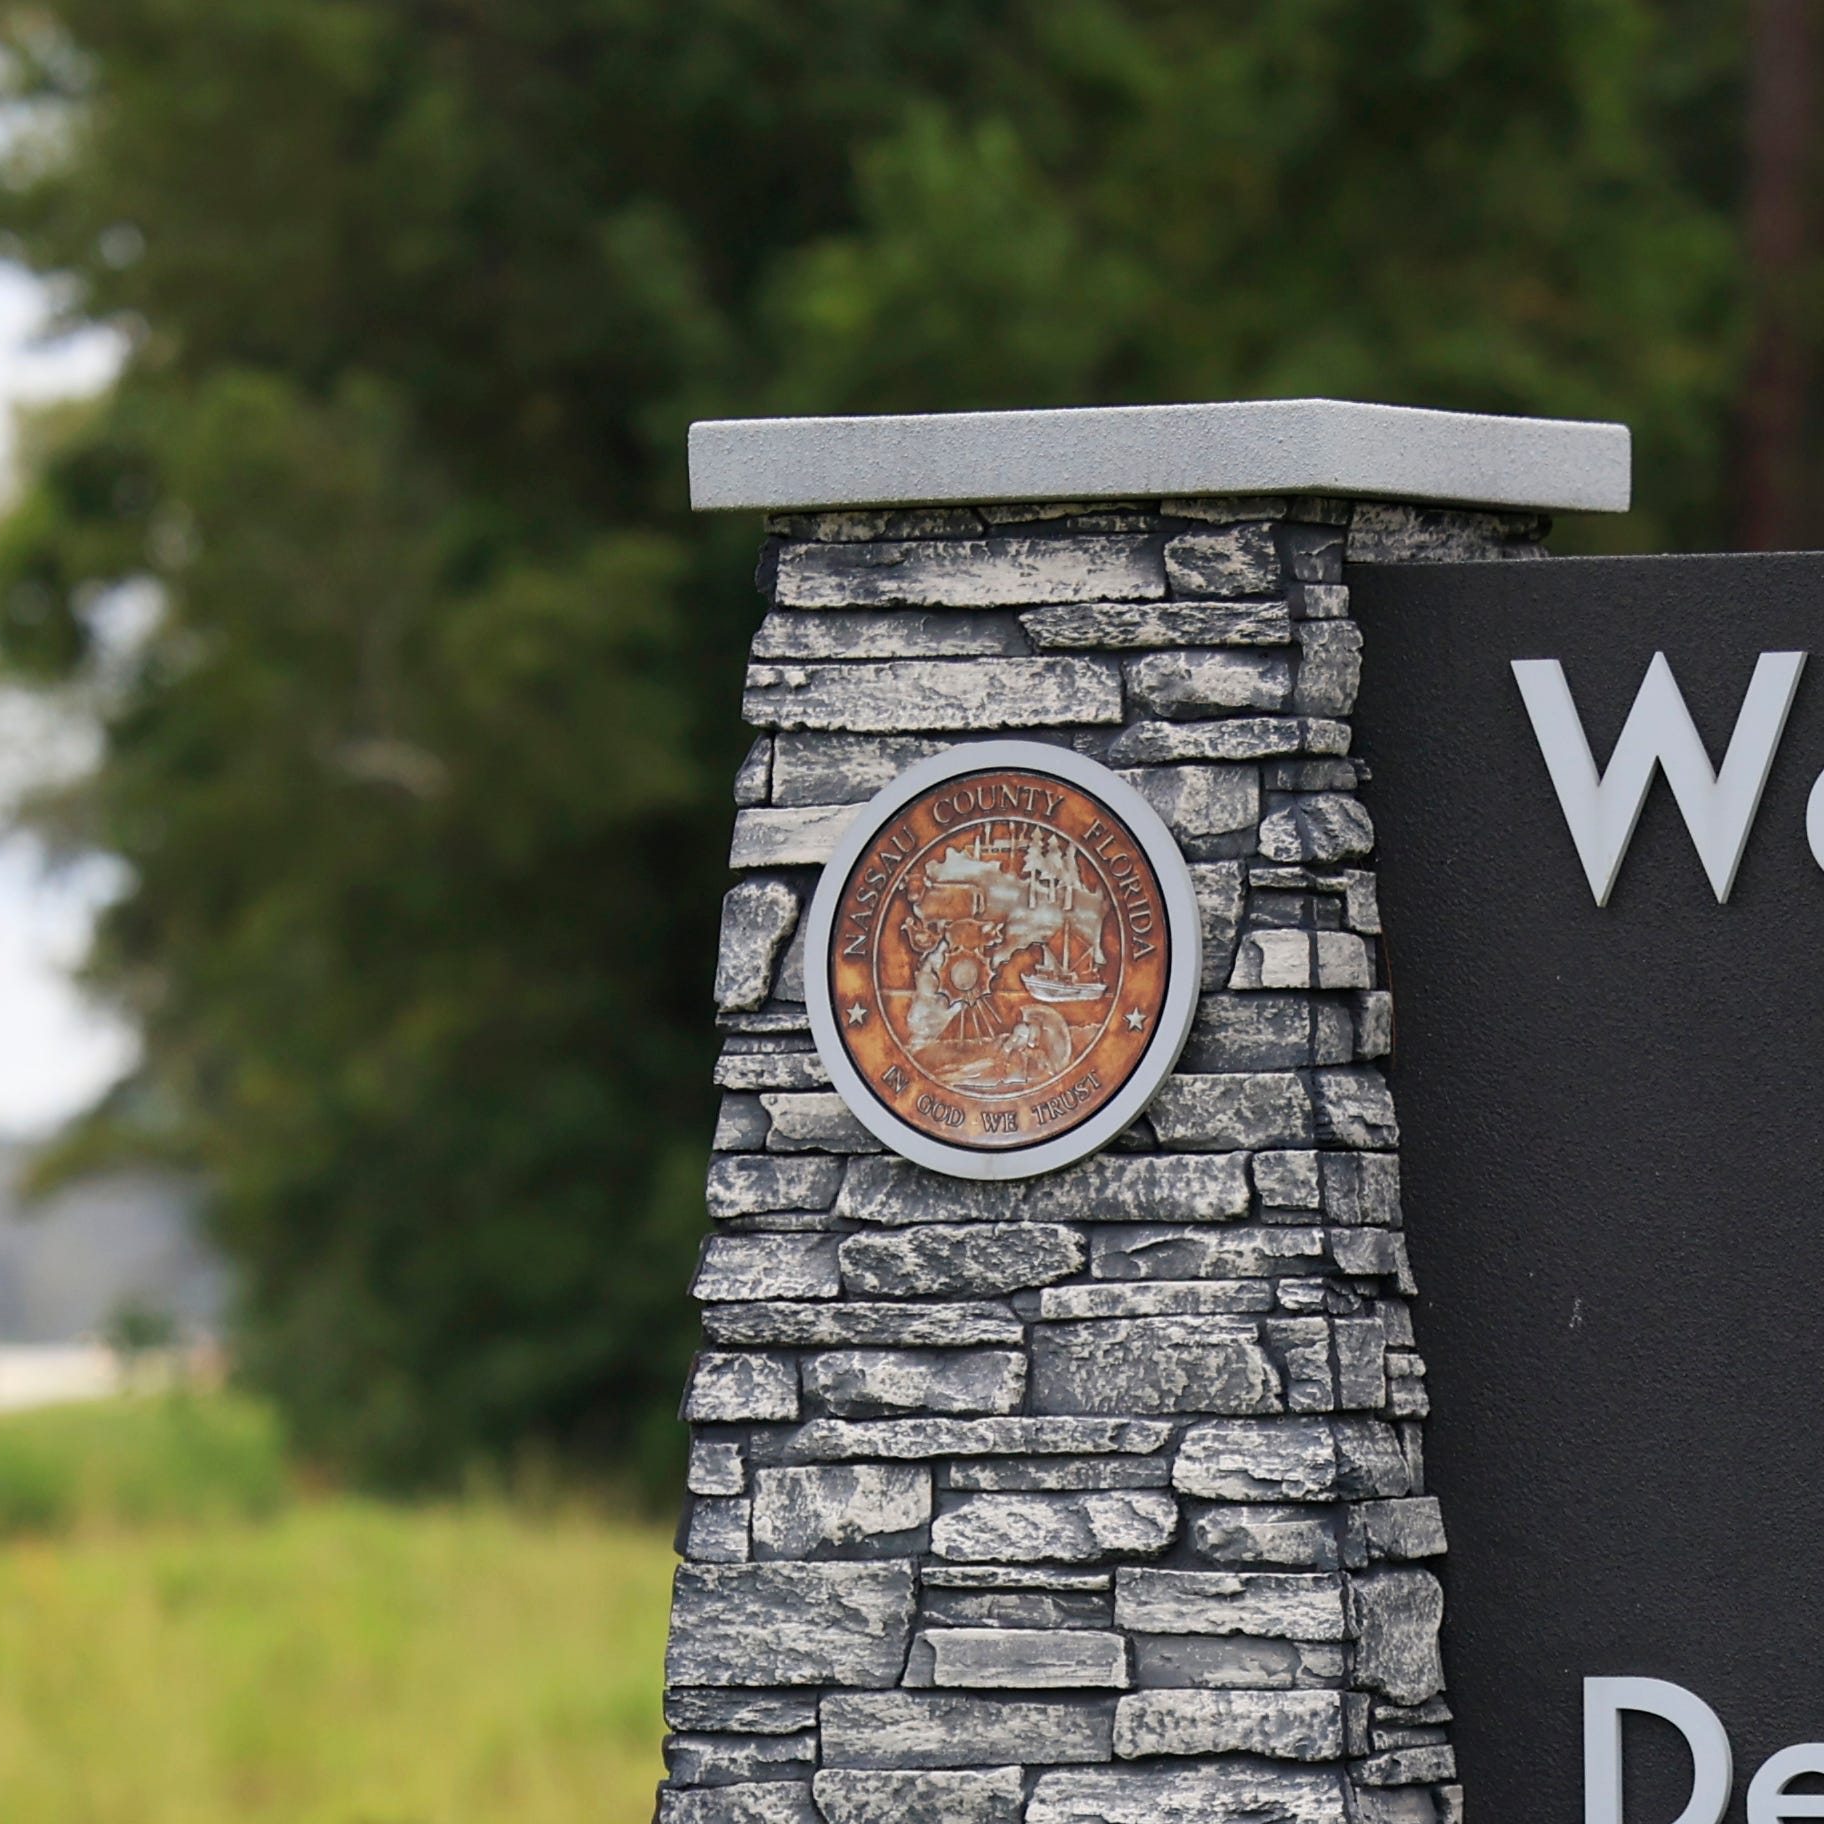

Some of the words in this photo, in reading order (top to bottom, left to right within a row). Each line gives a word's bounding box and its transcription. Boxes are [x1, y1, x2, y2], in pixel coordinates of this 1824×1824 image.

[845, 827, 920, 957] NASSAU
[931, 785, 1064, 824] COUNTY
[1083, 820, 1156, 960] FLORIDA
[881, 1064, 911, 1096] IN
[915, 1093, 965, 1129] GOD
[980, 1111, 1020, 1135] WE
[1031, 1069, 1102, 1126] TRUST
